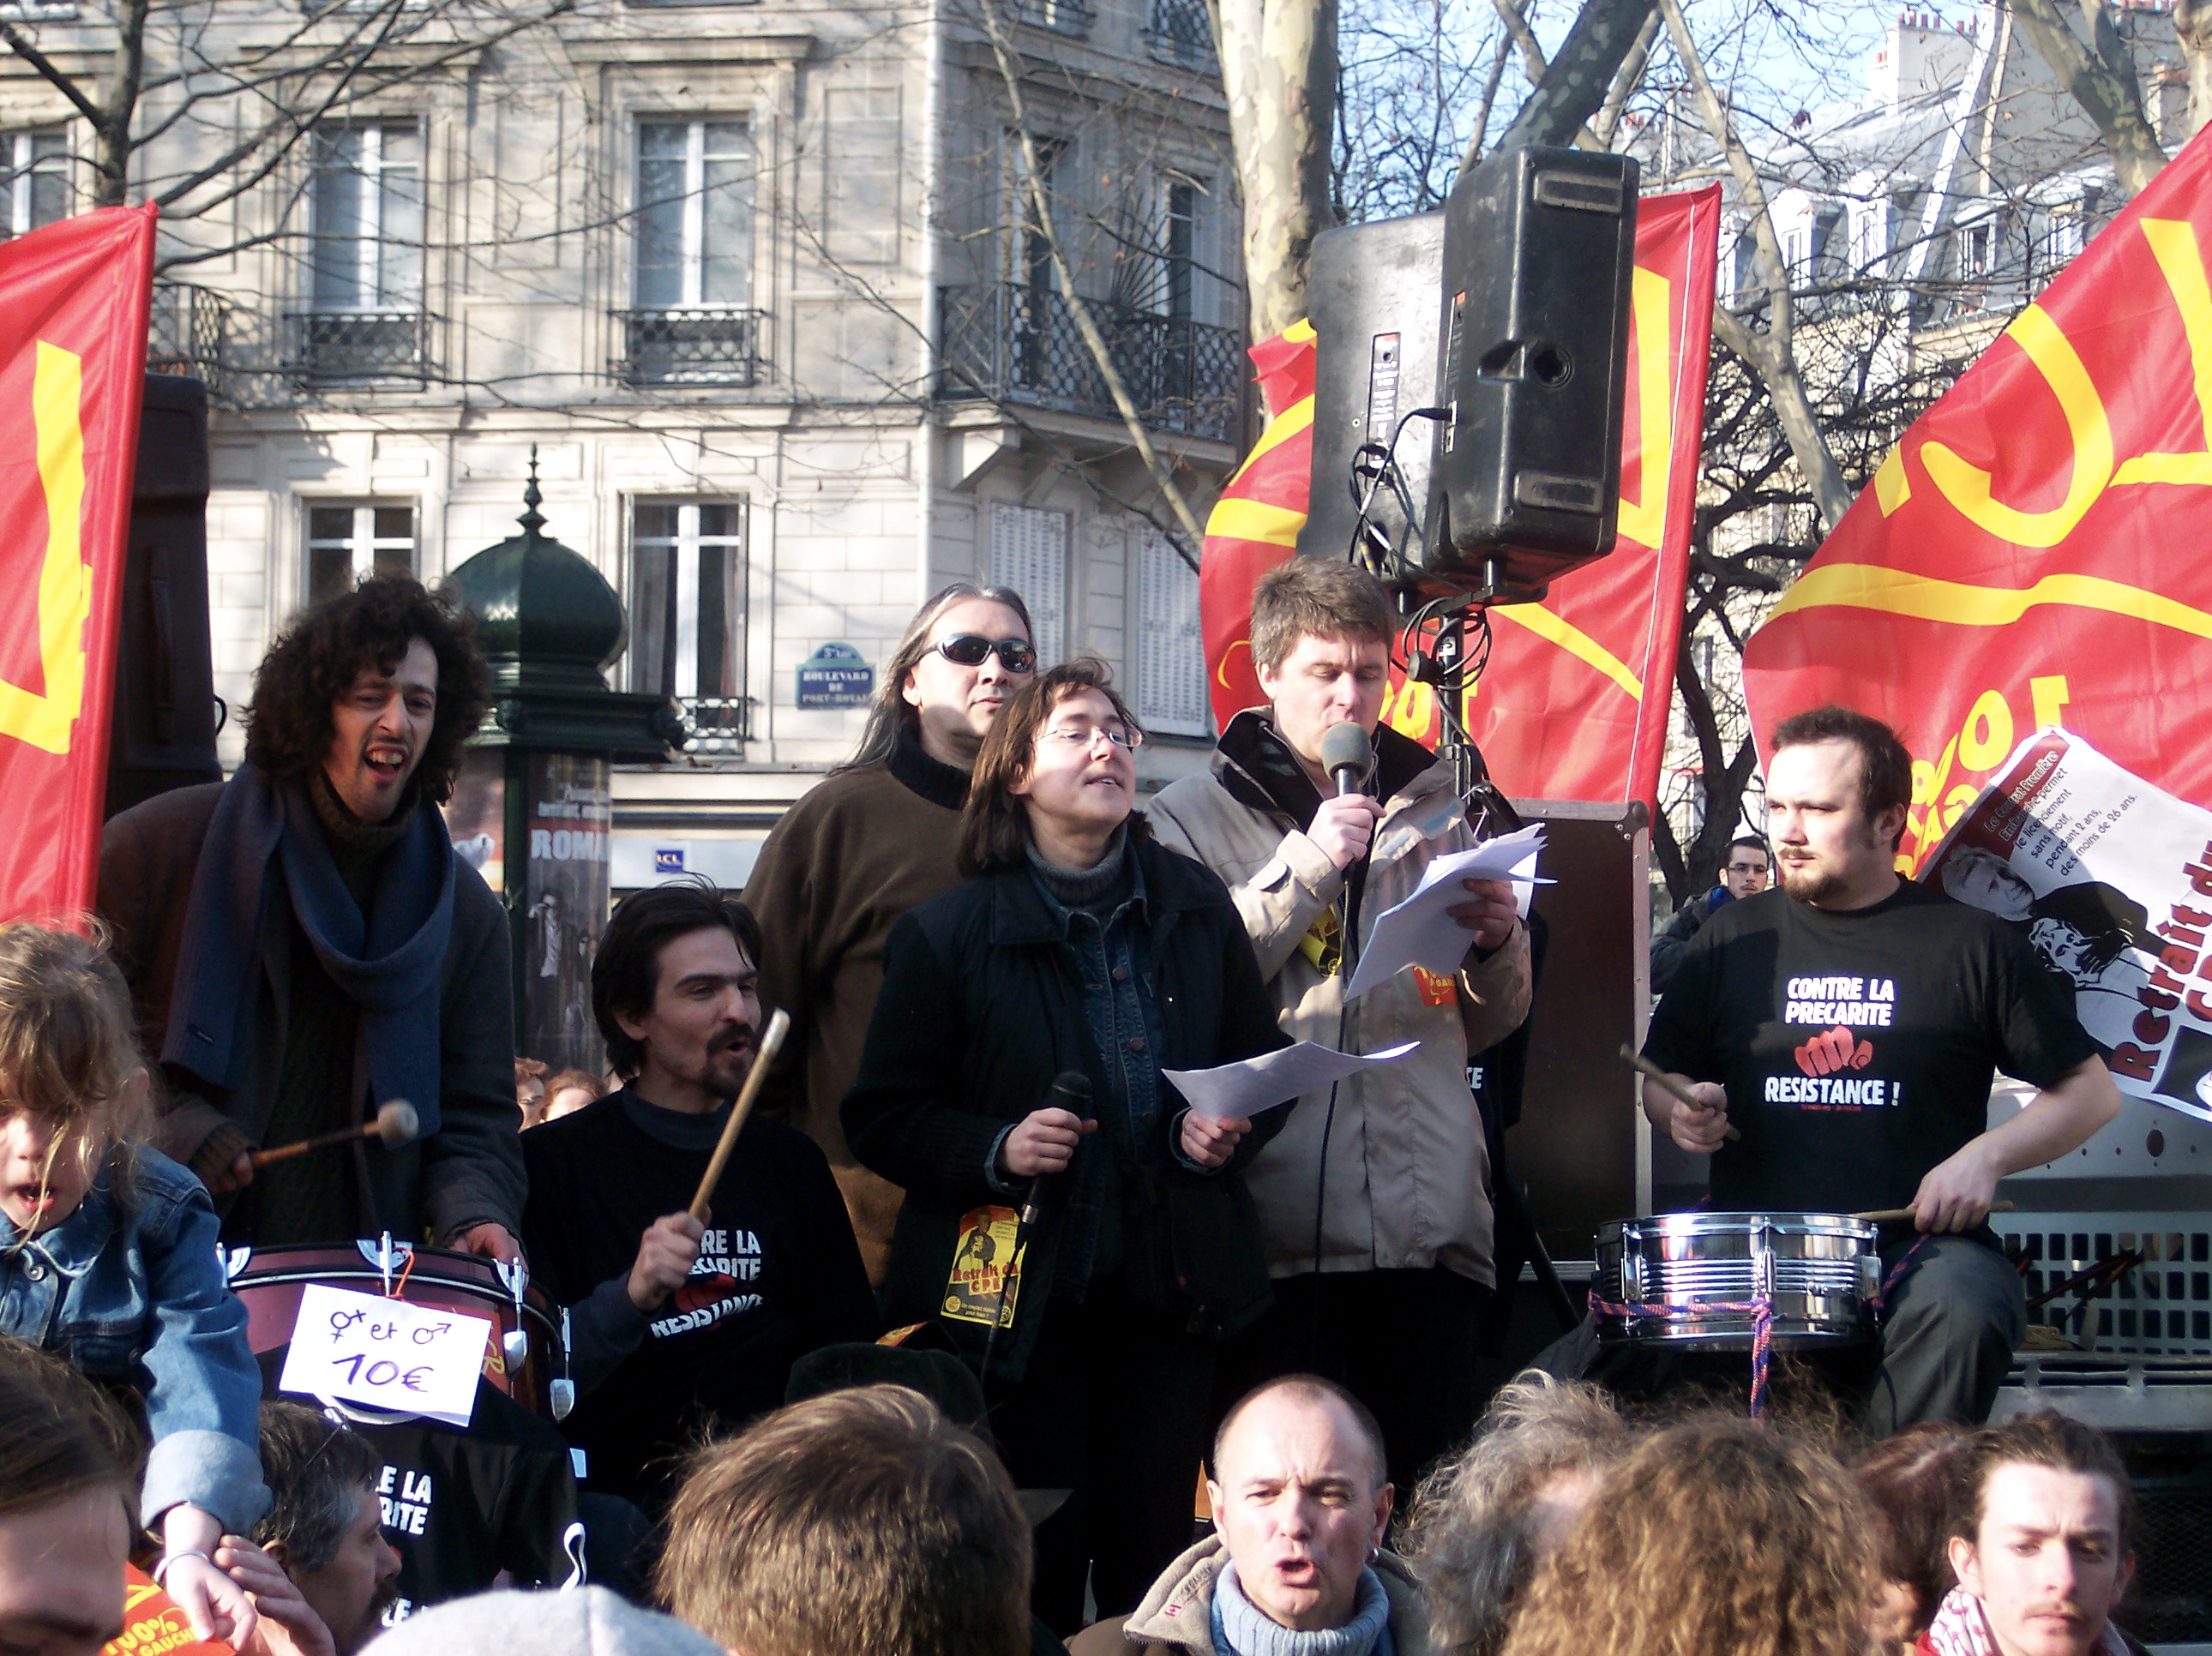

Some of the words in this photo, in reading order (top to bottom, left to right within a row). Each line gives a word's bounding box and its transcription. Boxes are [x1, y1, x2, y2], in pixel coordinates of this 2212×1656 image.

[803, 671, 869, 681] BOULEVARD
[828, 682, 844, 692] DE
[2020, 750, 2059, 793] Première
[2040, 767, 2069, 801] permet
[2014, 836, 2027, 850] le
[2023, 788, 2073, 839] licenciement
[2059, 855, 2079, 877] des
[2075, 832, 2101, 857] moins
[2097, 819, 2112, 834] de
[2107, 808, 2122, 824] 26
[2120, 793, 2138, 811] ans.
[2030, 834, 2052, 860] sans
[2048, 813, 2074, 837] motif,
[2045, 828, 2081, 870] pendant
[2075, 821, 2086, 832] 2
[2083, 808, 2103, 825] ans,
[1788, 977, 1863, 1000] CONTRE
[1869, 979, 1895, 1001] LA
[2109, 903, 2212, 1083] Retrait
[1785, 1001, 1892, 1026] PRECARITE
[1764, 1077, 1885, 1106] RESISTANCE
[1891, 1082, 1901, 1106] !
[736, 1230, 761, 1254] LA
[370, 1322, 398, 1340] et
[332, 1353, 434, 1393] 10€
[402, 1471, 431, 1503] LA
[139, 1627, 196, 1656] GAUCH
